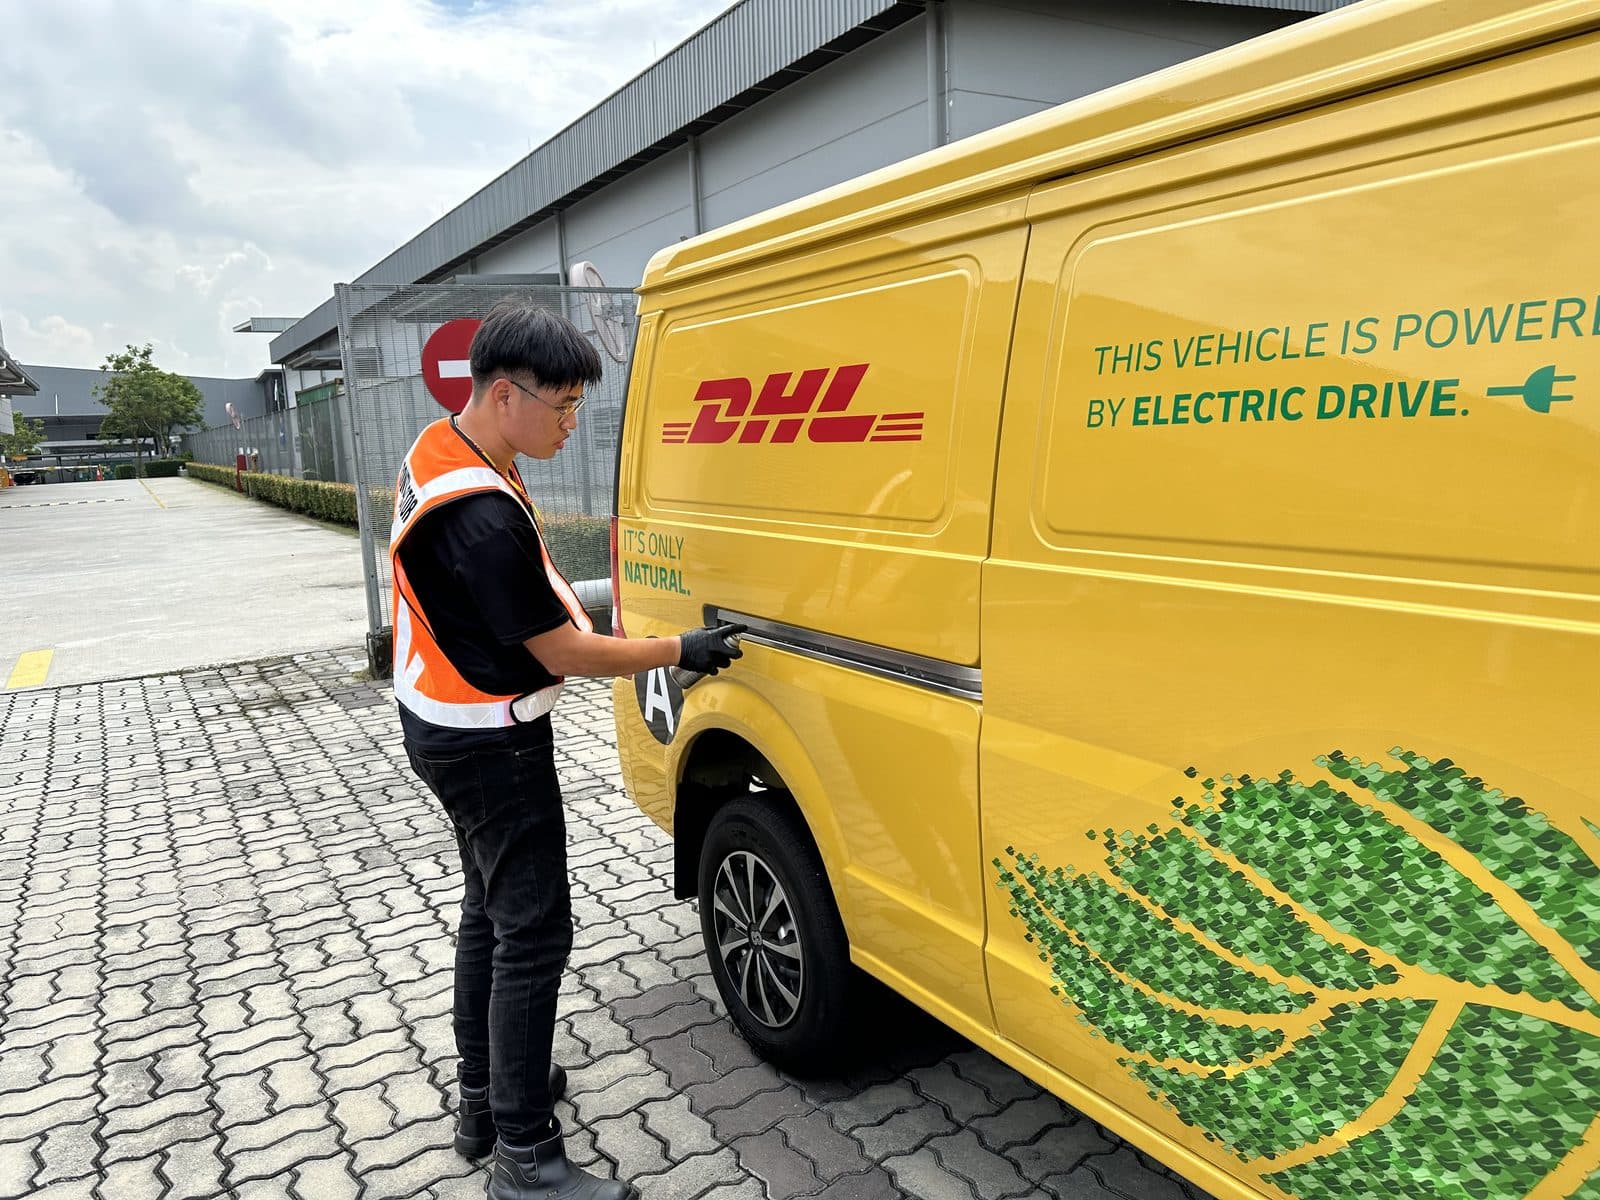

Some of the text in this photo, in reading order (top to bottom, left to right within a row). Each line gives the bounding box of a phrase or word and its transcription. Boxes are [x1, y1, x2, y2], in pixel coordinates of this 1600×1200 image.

[1094, 295, 1600, 375] THIS VEHICLE IS POWER
[686, 362, 878, 444] DHL
[1086, 376, 1471, 430] BY ELECTRIC DRIVE.
[624, 529, 684, 560] IT'S ONLY
[624, 560, 691, 596] NATURAL.
[643, 666, 675, 736] A
